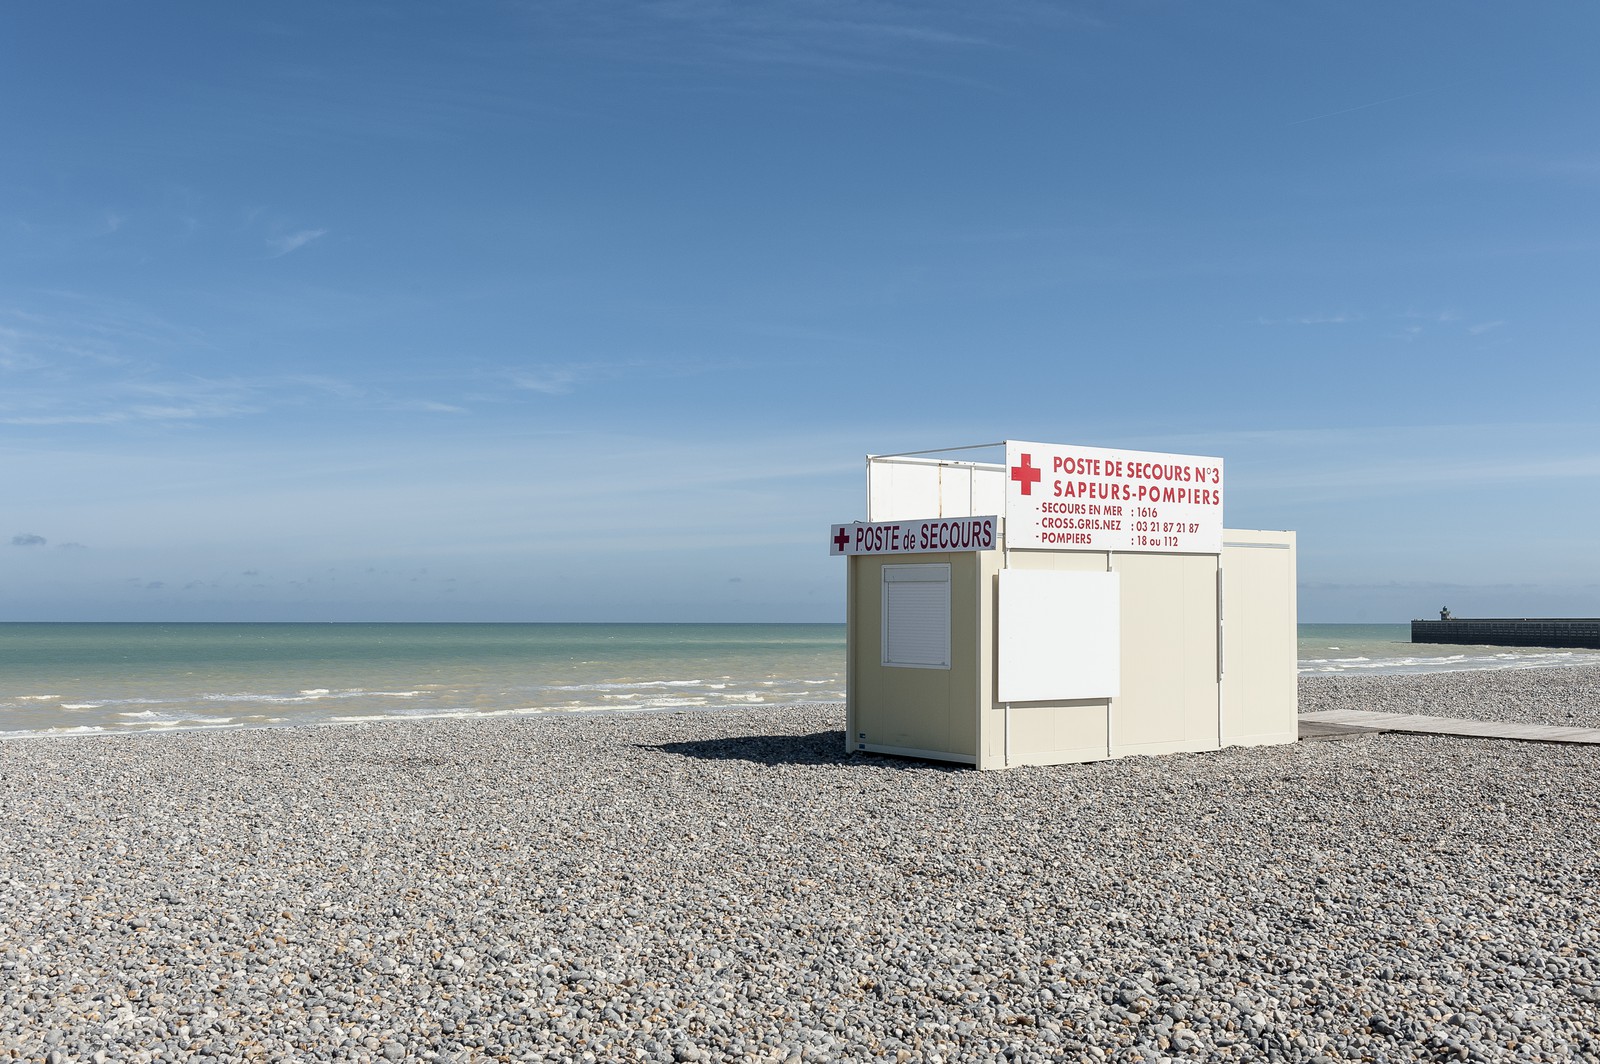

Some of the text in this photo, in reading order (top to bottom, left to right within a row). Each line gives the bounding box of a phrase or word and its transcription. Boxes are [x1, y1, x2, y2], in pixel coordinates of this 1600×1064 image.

[1054, 457, 1219, 484] POSTE DE SECOURS N°3
[1053, 480, 1220, 505] SAPEURS-POMPIERS
[1042, 502, 1086, 514] SECOURS
[1089, 505, 1100, 514] EN
[1104, 506, 1122, 516] MER
[1138, 507, 1157, 518] 1616
[1042, 517, 1121, 530] CROSS.GRIS.NEZ
[1137, 521, 1147, 531] 03
[1151, 522, 1159, 531] 21
[1164, 522, 1174, 532] 87
[1177, 523, 1185, 532] 21
[1189, 523, 1199, 533] 87
[856, 520, 992, 551] POSTE de SECOURS
[1042, 533, 1091, 544] POMPIERS
[1138, 536, 1147, 545] 18
[1165, 537, 1177, 546] 112
